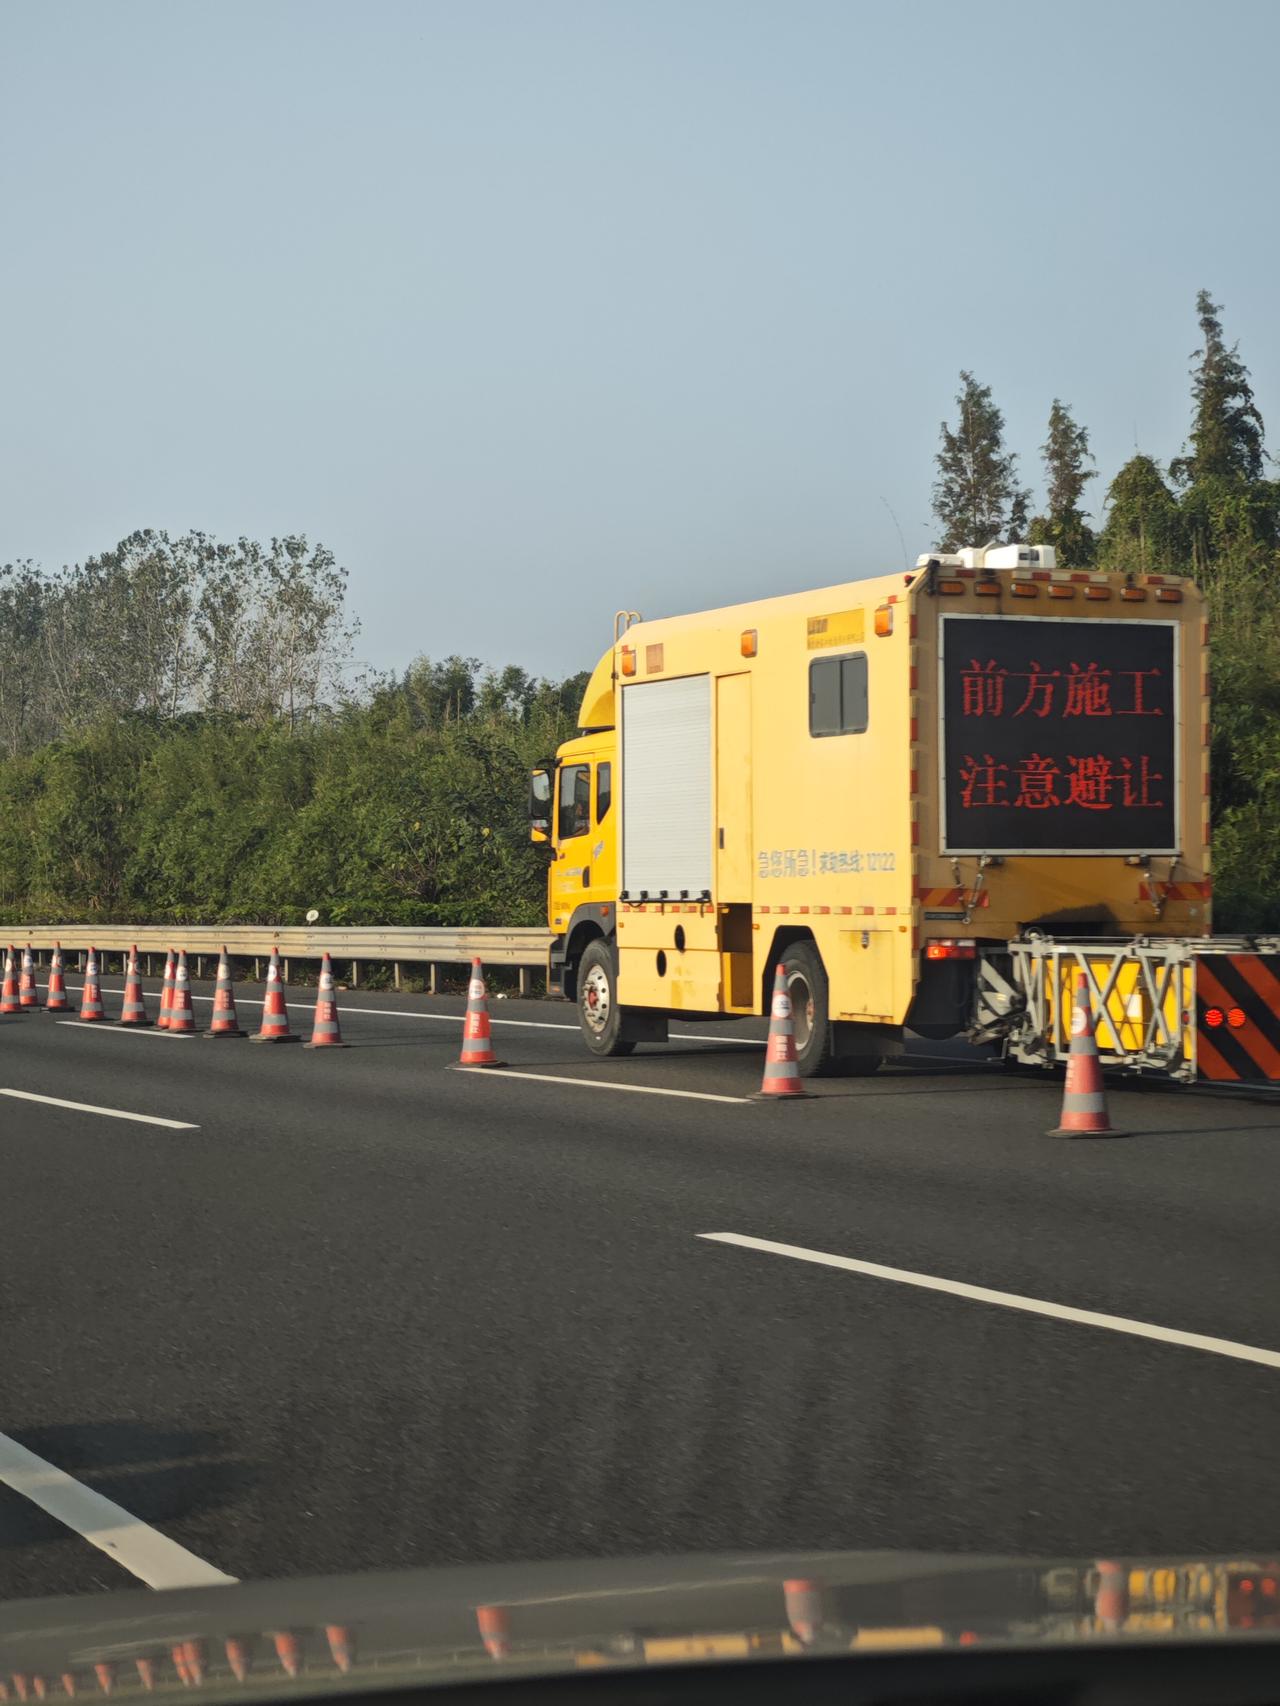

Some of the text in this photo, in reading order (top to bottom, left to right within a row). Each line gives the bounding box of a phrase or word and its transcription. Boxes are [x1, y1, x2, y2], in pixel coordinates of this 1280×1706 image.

[960, 659, 1163, 718] 前方施工
[960, 752, 1163, 810] 注意避让
